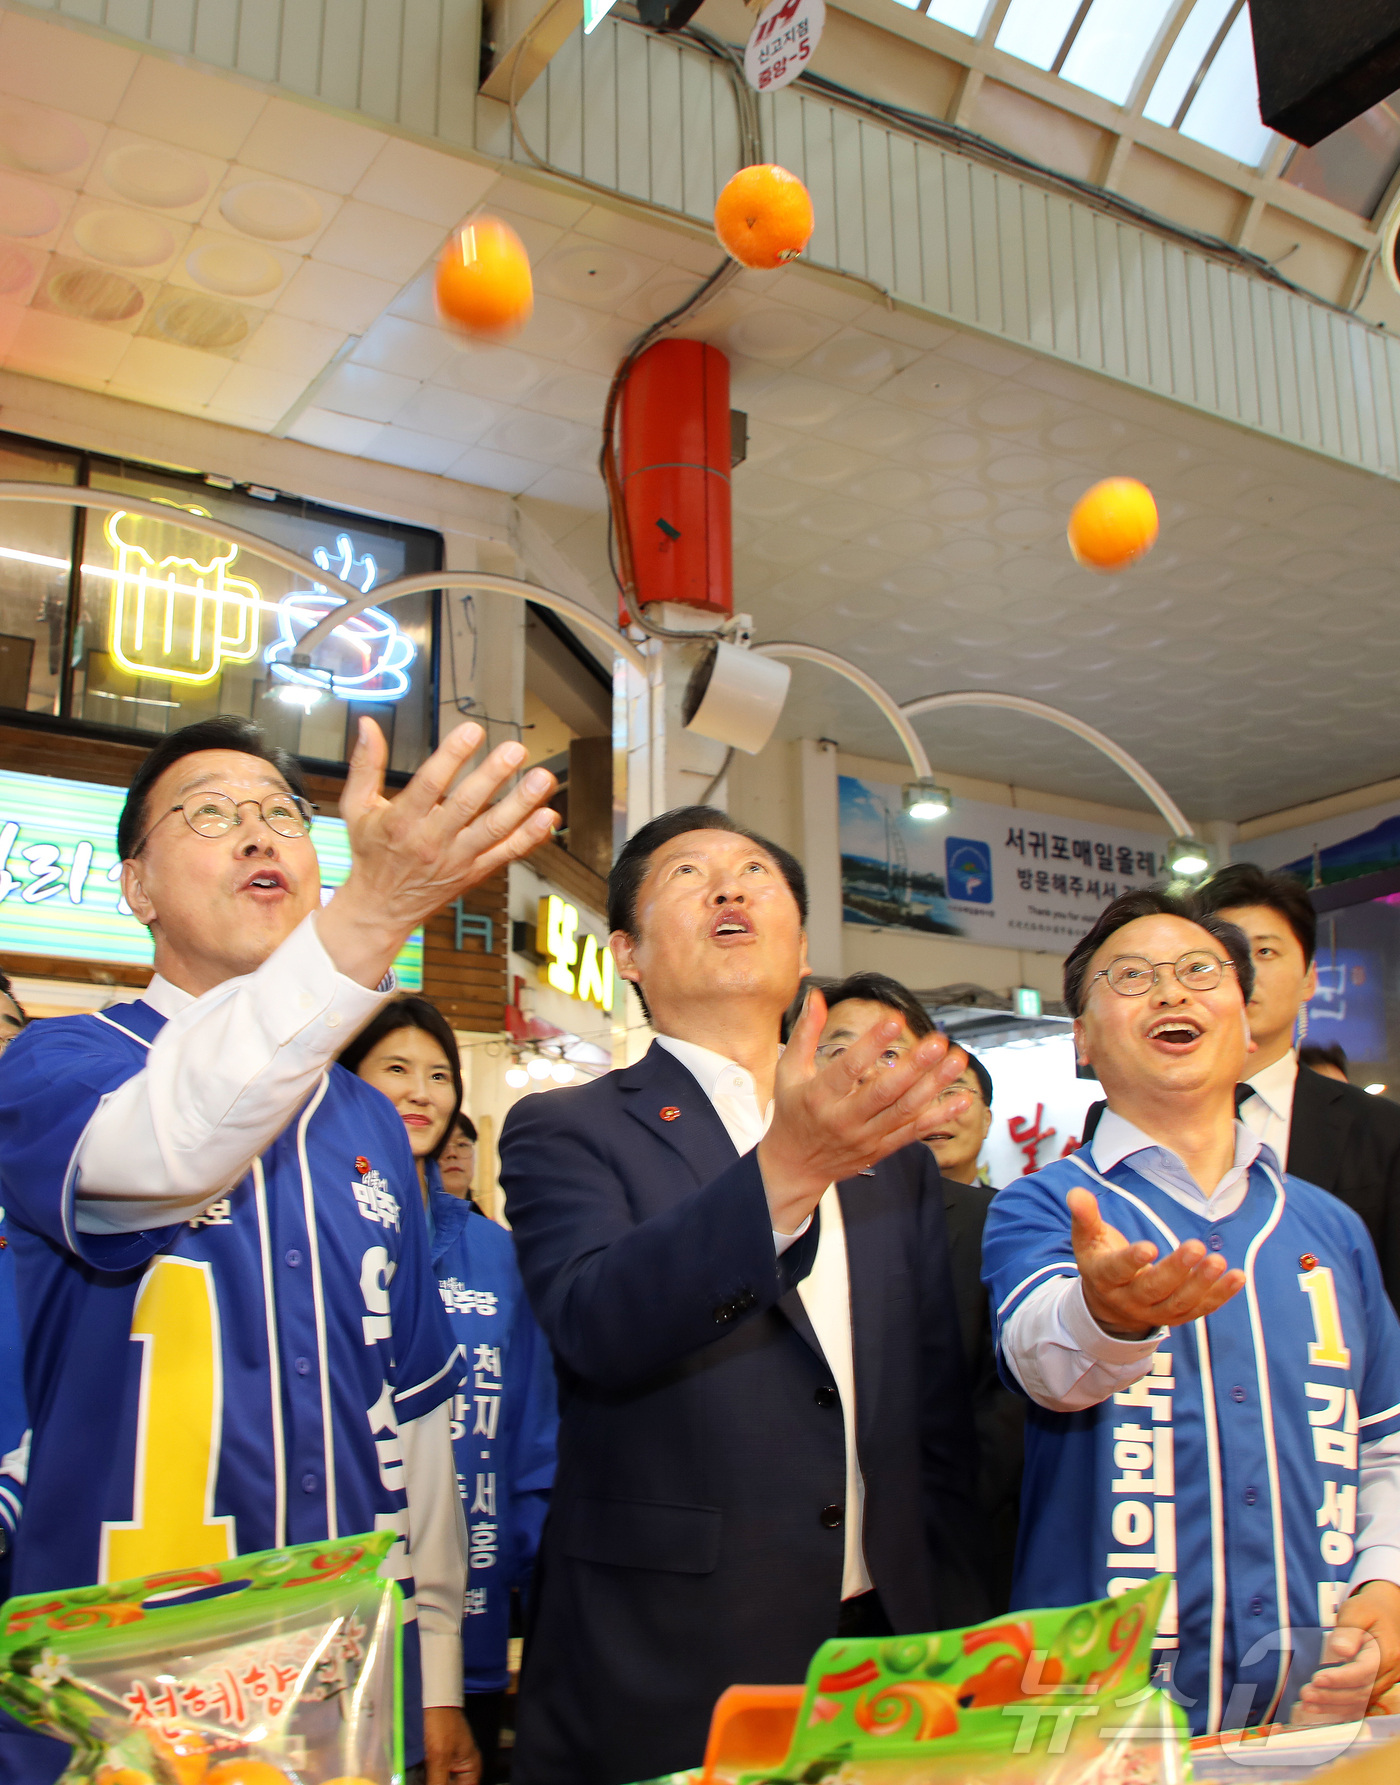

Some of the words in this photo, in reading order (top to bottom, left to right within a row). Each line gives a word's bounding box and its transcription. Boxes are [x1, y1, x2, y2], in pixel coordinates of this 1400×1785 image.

[754, 0, 801, 47] 119
[758, 17, 809, 64] 신고지점
[758, 37, 811, 89] 중앙-5
[0, 822, 95, 904] 리
[1017, 867, 1117, 900] 방문해주셔서
[1007, 1102, 1082, 1176] 달
[351, 1181, 401, 1233] 민주
[1298, 1266, 1351, 1370] 1
[99, 1254, 238, 1586] 1
[127, 1663, 300, 1739] 천혜향
